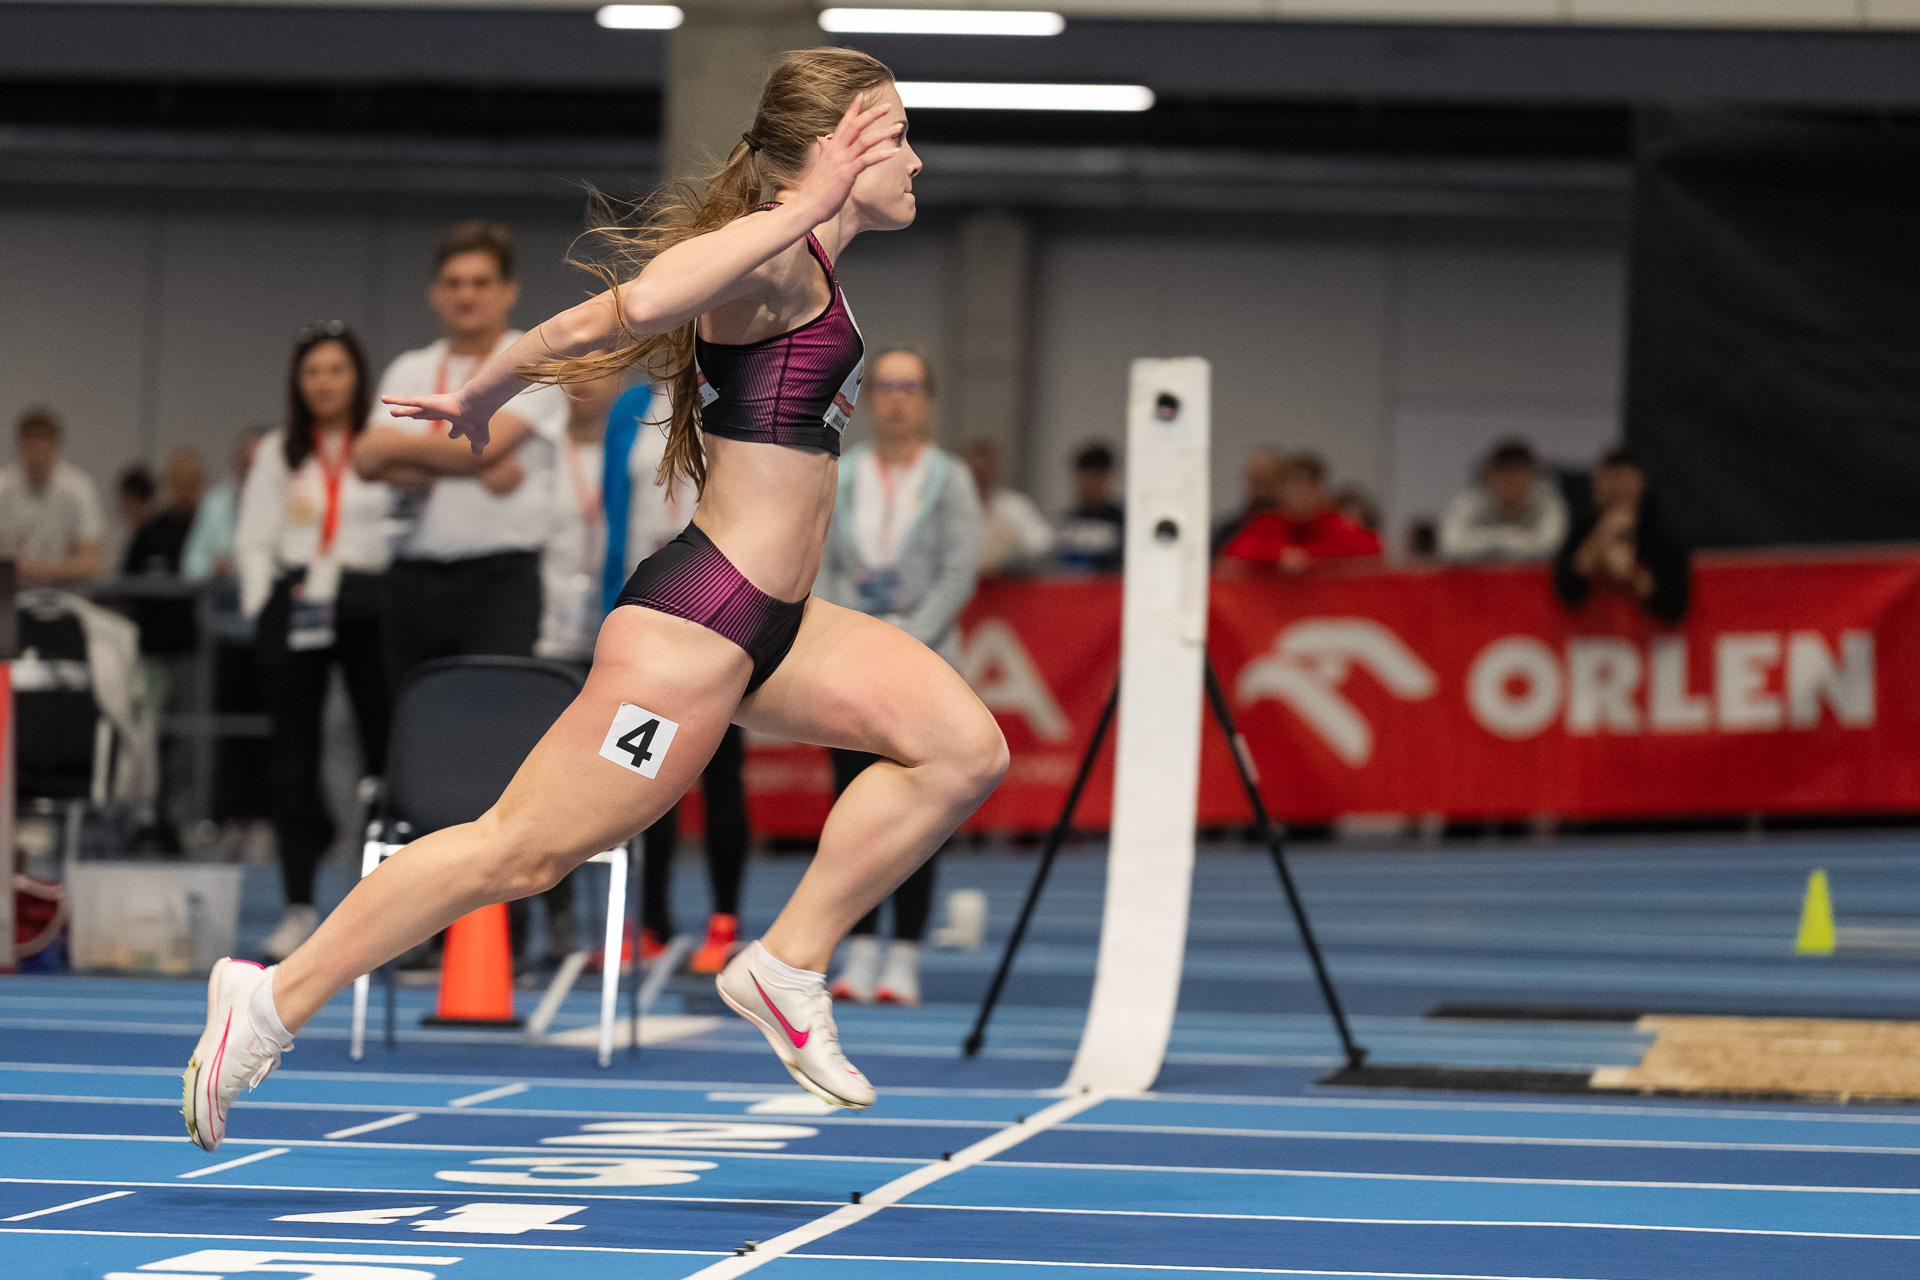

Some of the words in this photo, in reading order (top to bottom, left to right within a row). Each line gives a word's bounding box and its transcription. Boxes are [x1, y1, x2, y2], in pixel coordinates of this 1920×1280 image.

[1467, 631, 1875, 738] ORLEN
[616, 718, 660, 768] 4
[540, 1121, 819, 1150] 2
[434, 1157, 719, 1187] 3
[270, 1202, 589, 1235] 4
[104, 1249, 465, 1280] 5
